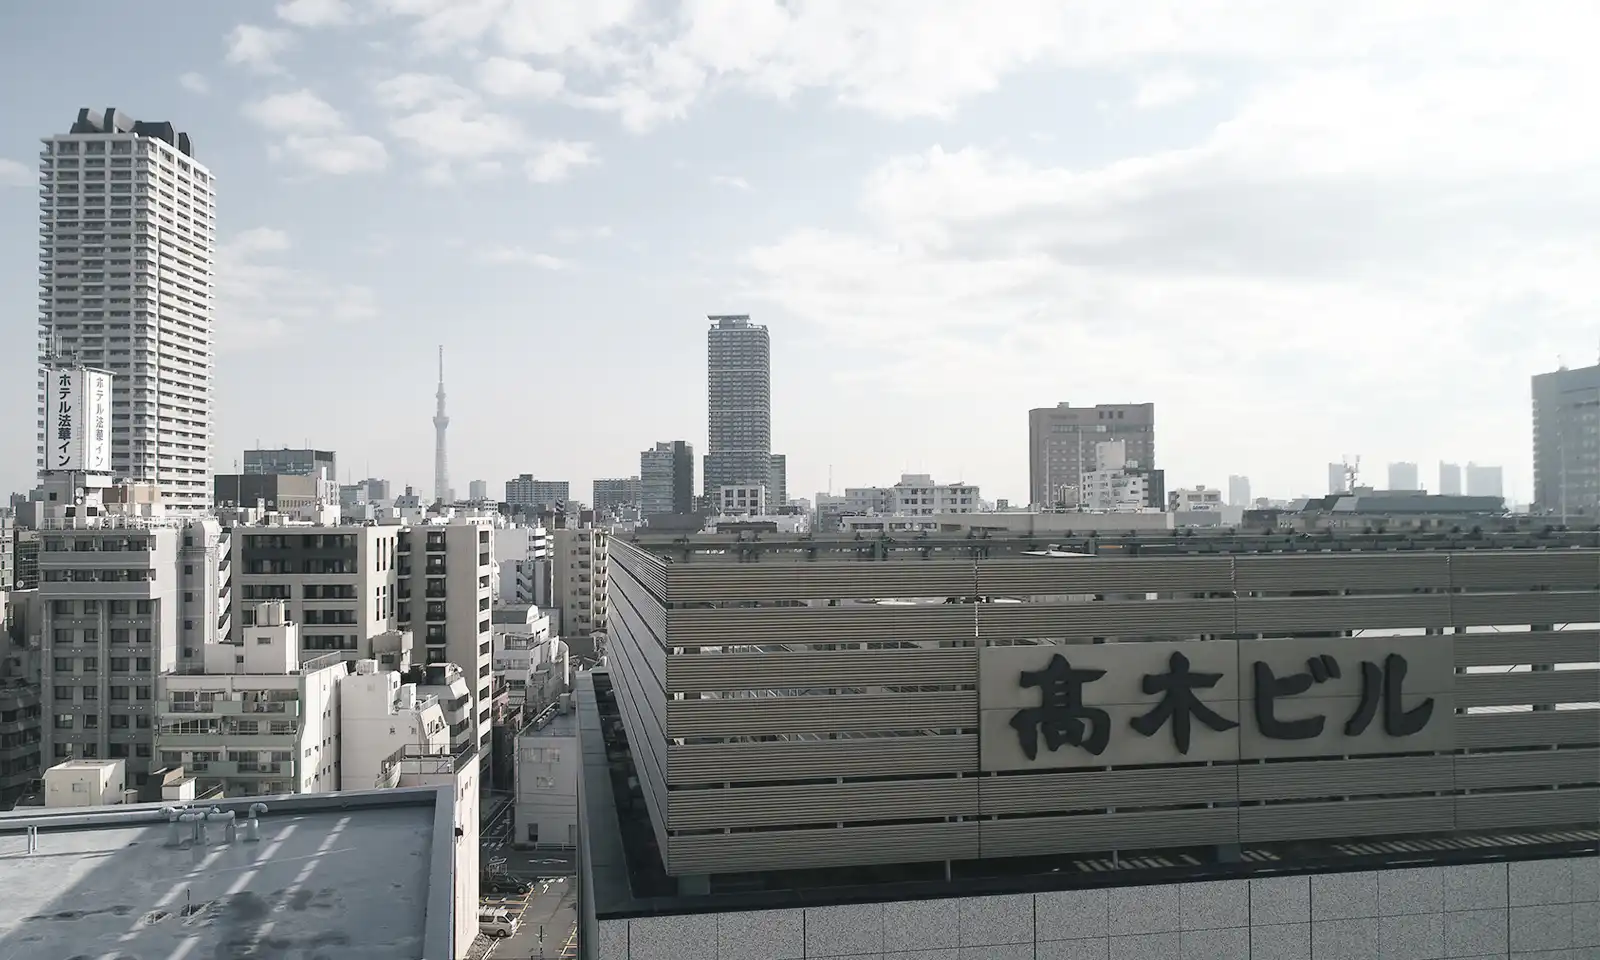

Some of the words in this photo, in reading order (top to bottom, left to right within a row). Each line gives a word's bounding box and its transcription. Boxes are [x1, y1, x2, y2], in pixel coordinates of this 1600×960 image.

[58, 374, 71, 467] ホテル法華イン
